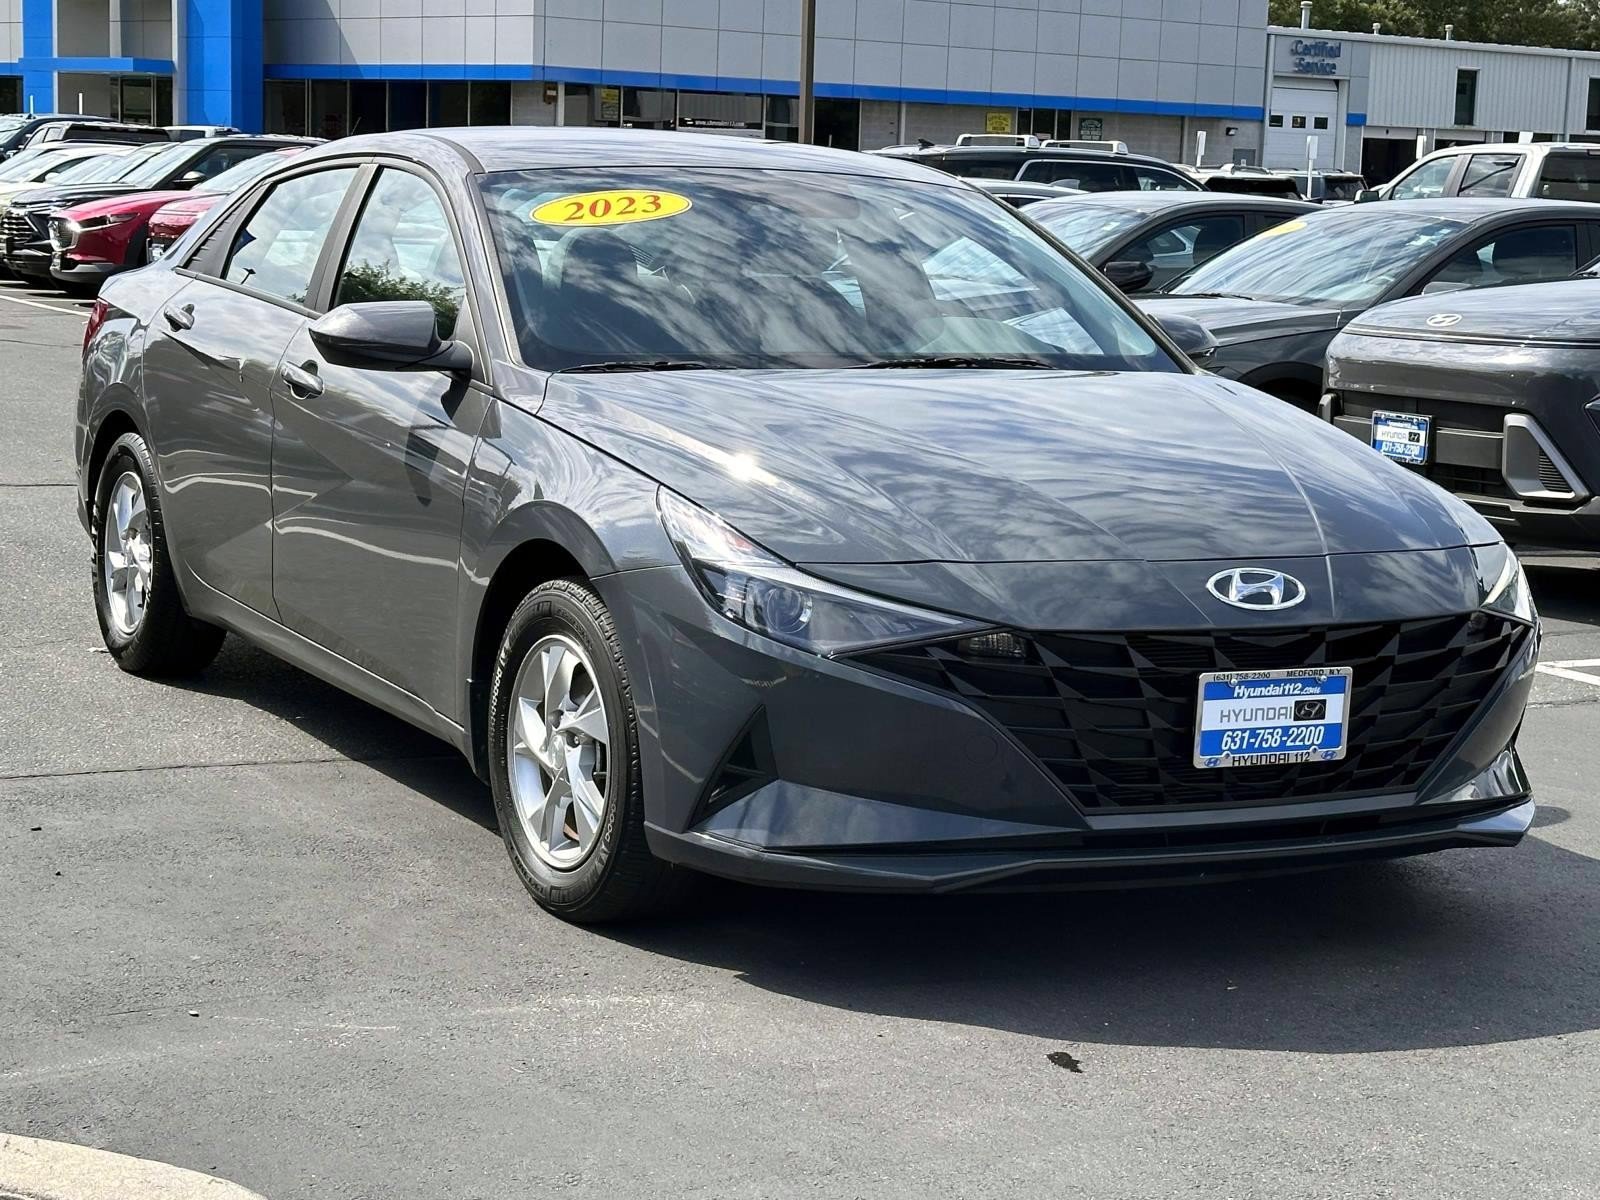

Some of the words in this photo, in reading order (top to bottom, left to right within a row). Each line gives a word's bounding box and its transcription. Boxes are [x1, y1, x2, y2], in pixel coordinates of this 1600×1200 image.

[1291, 39, 1342, 58] Certified
[1294, 57, 1337, 75] Service
[563, 194, 662, 222] 2023
[1235, 671, 1271, 680] 758-2200
[1219, 705, 1292, 723] HYUNDAI
[1221, 725, 1325, 751] 631-758-2200
[1232, 752, 1290, 767] HYUNDAI
[1294, 751, 1310, 762] 112
